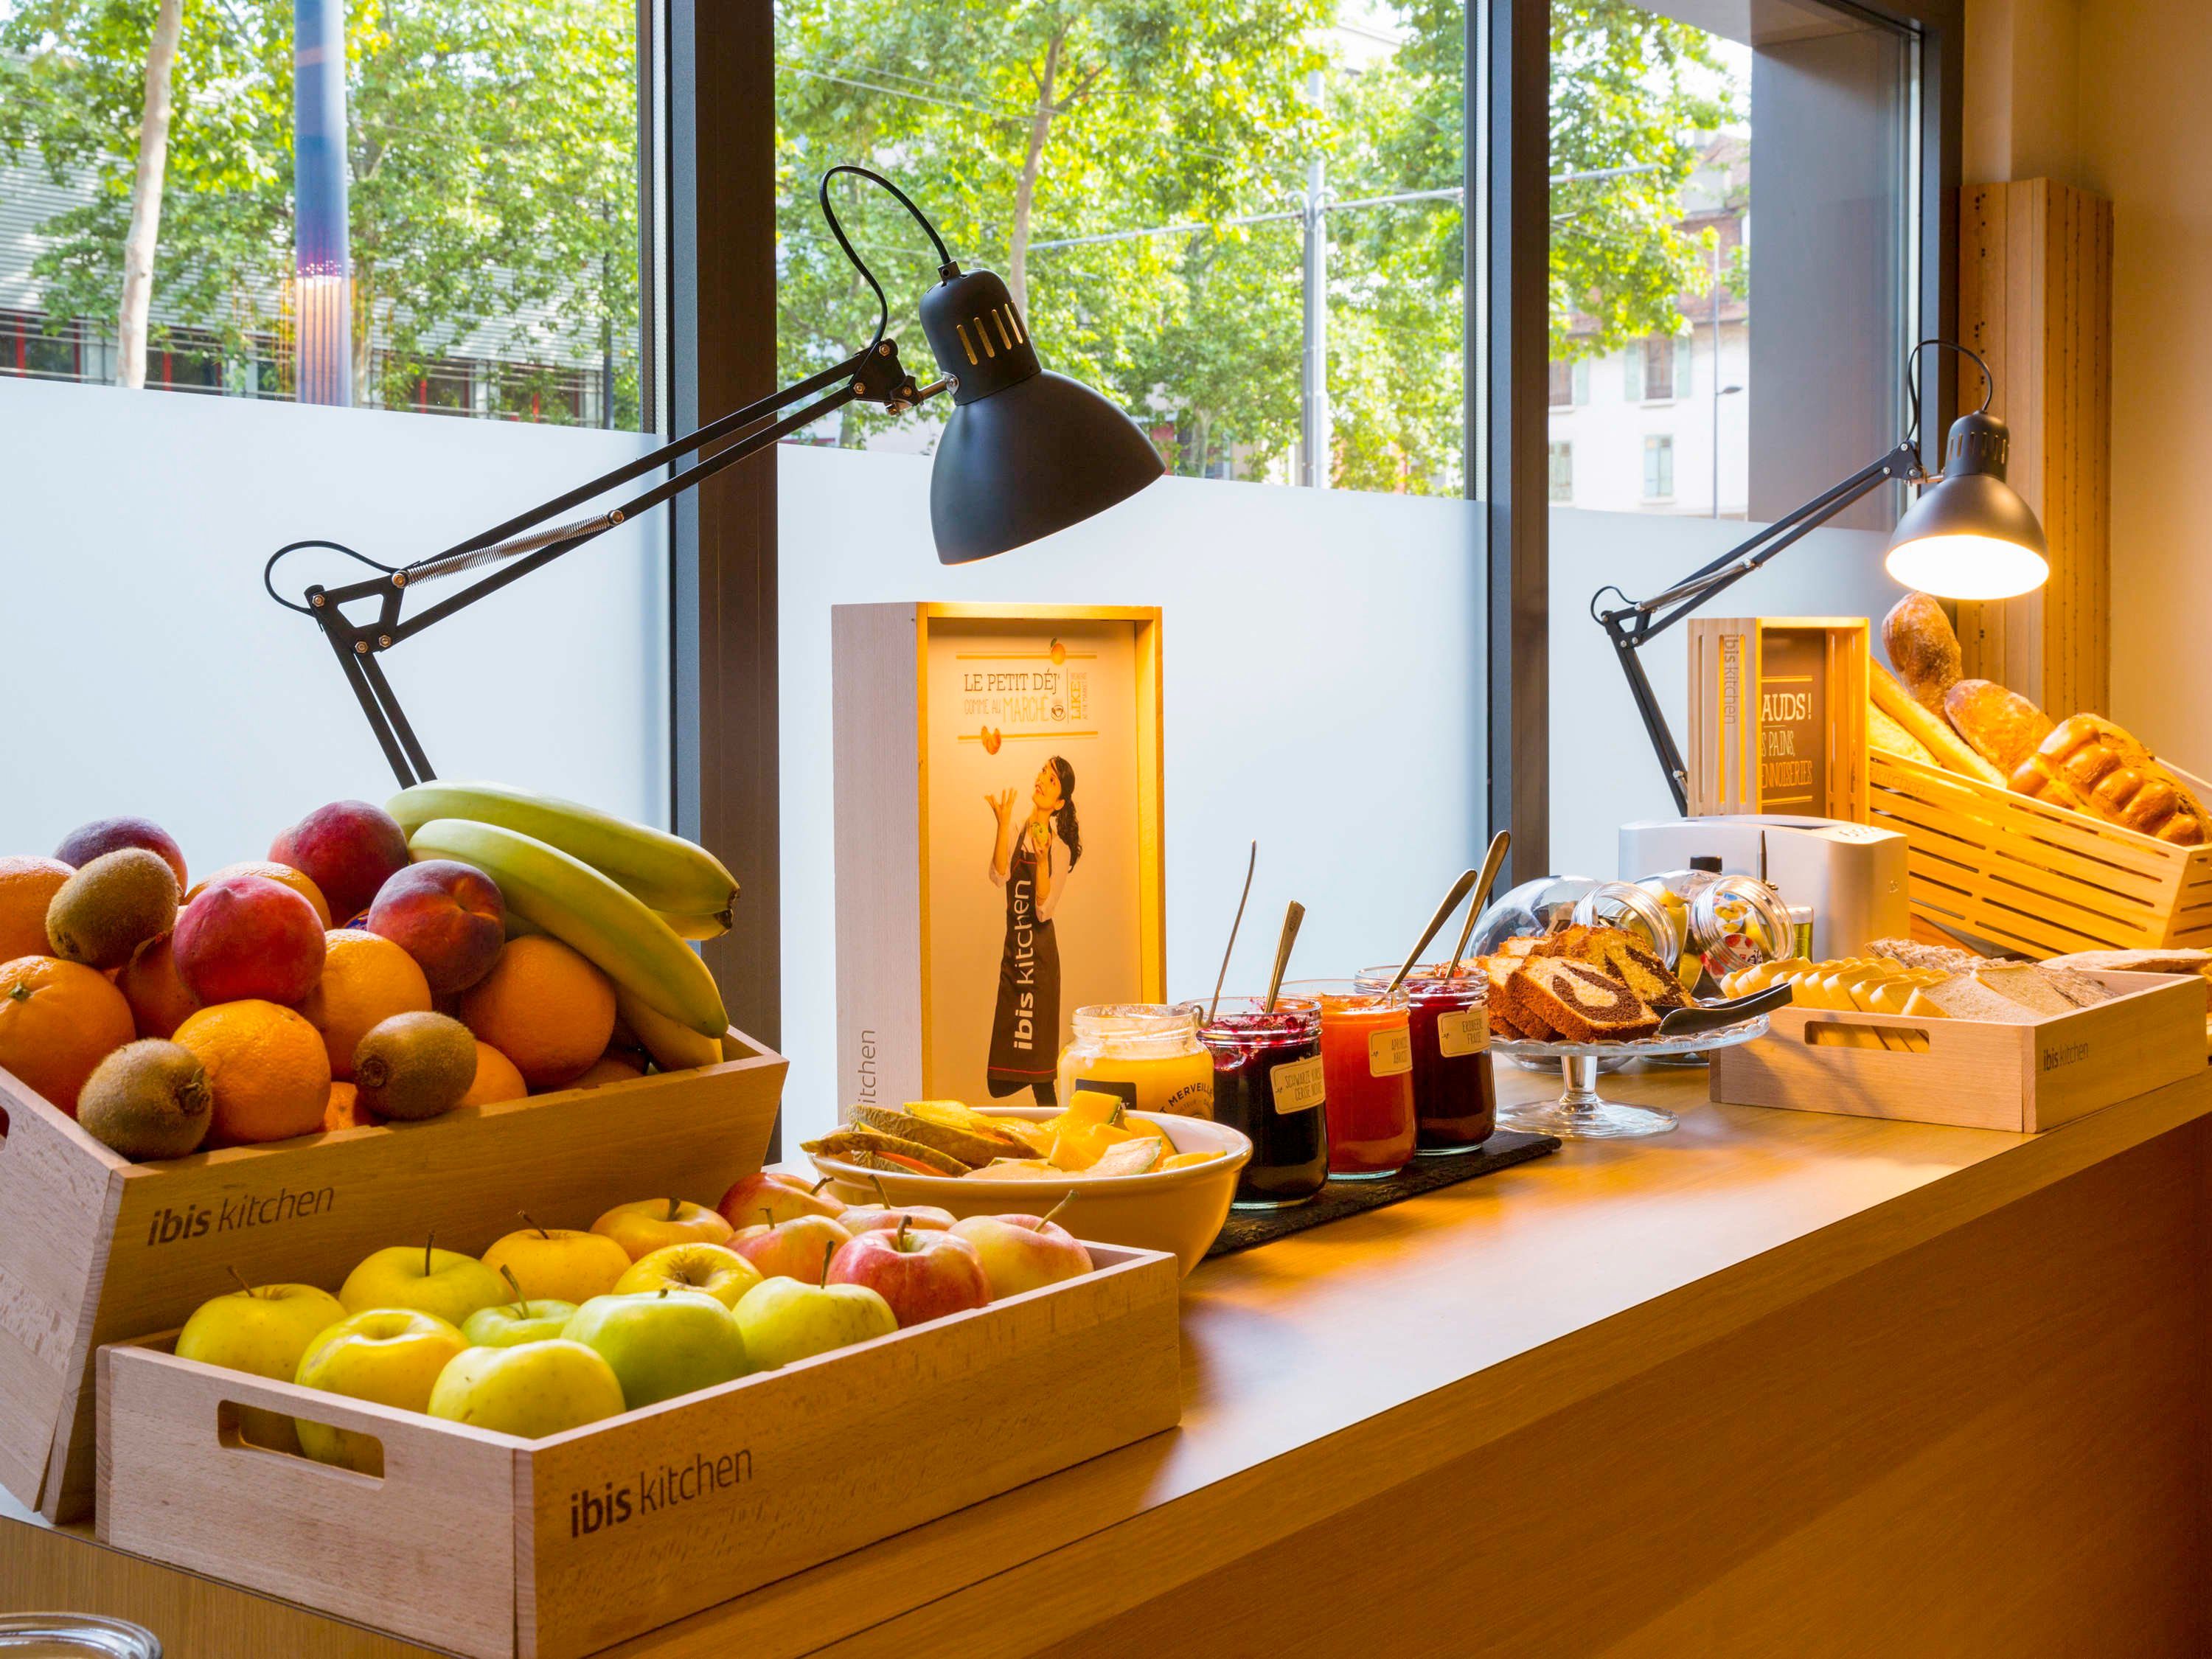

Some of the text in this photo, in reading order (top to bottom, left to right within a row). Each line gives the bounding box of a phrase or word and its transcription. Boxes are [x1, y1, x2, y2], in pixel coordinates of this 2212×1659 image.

[964, 672, 983, 692] LE
[987, 672, 1029, 692] PETIT
[1071, 681, 1082, 720] LIKE
[1724, 666, 1739, 725] kitchen
[1003, 694, 1050, 723] MARCHÉ
[1761, 692, 1812, 722] AUDS!
[1761, 759, 1813, 790] ENNOISERIES
[1014, 880, 1034, 1050] ibis kitchen
[858, 1030, 877, 1104] itchen
[2043, 1040, 2089, 1072] ibis kitchen
[147, 1186, 335, 1246] ibis kitchen
[570, 1449, 753, 1539] ibis kitchen
